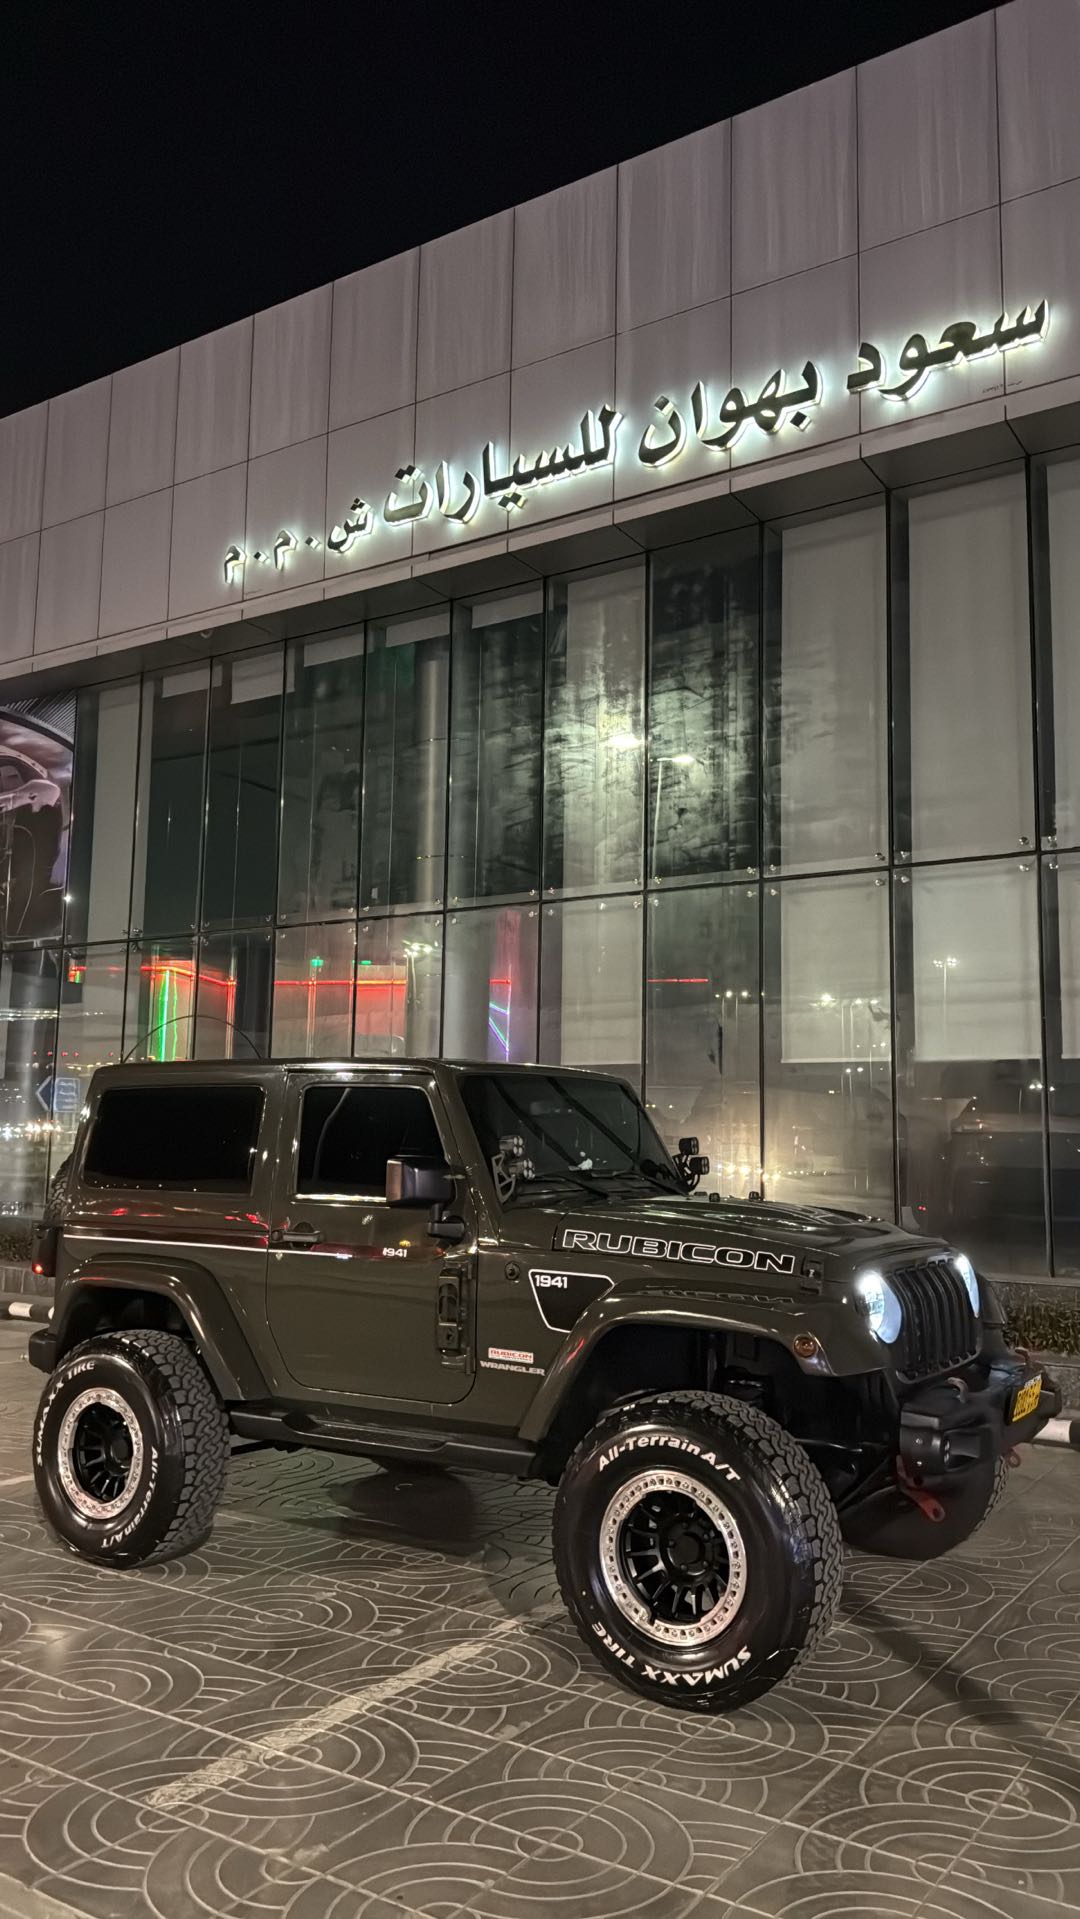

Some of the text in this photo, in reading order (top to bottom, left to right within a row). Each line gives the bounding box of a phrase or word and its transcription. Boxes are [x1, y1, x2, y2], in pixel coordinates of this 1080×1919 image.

[846, 299, 1050, 402] سعود
[638, 360, 823, 468] بهوان
[383, 404, 625, 526] للسيارات
[382, 1247, 408, 1258] 1941
[562, 1229, 796, 1274] RUBICON
[534, 1274, 568, 1289] 1941
[66, 1360, 96, 1380] TIRE
[479, 1360, 546, 1376] WRANGLER
[490, 1349, 533, 1360] RUBICON
[599, 1435, 741, 1481] All-Terrain A/T
[591, 1621, 752, 1686] SUMAXX TIRE
